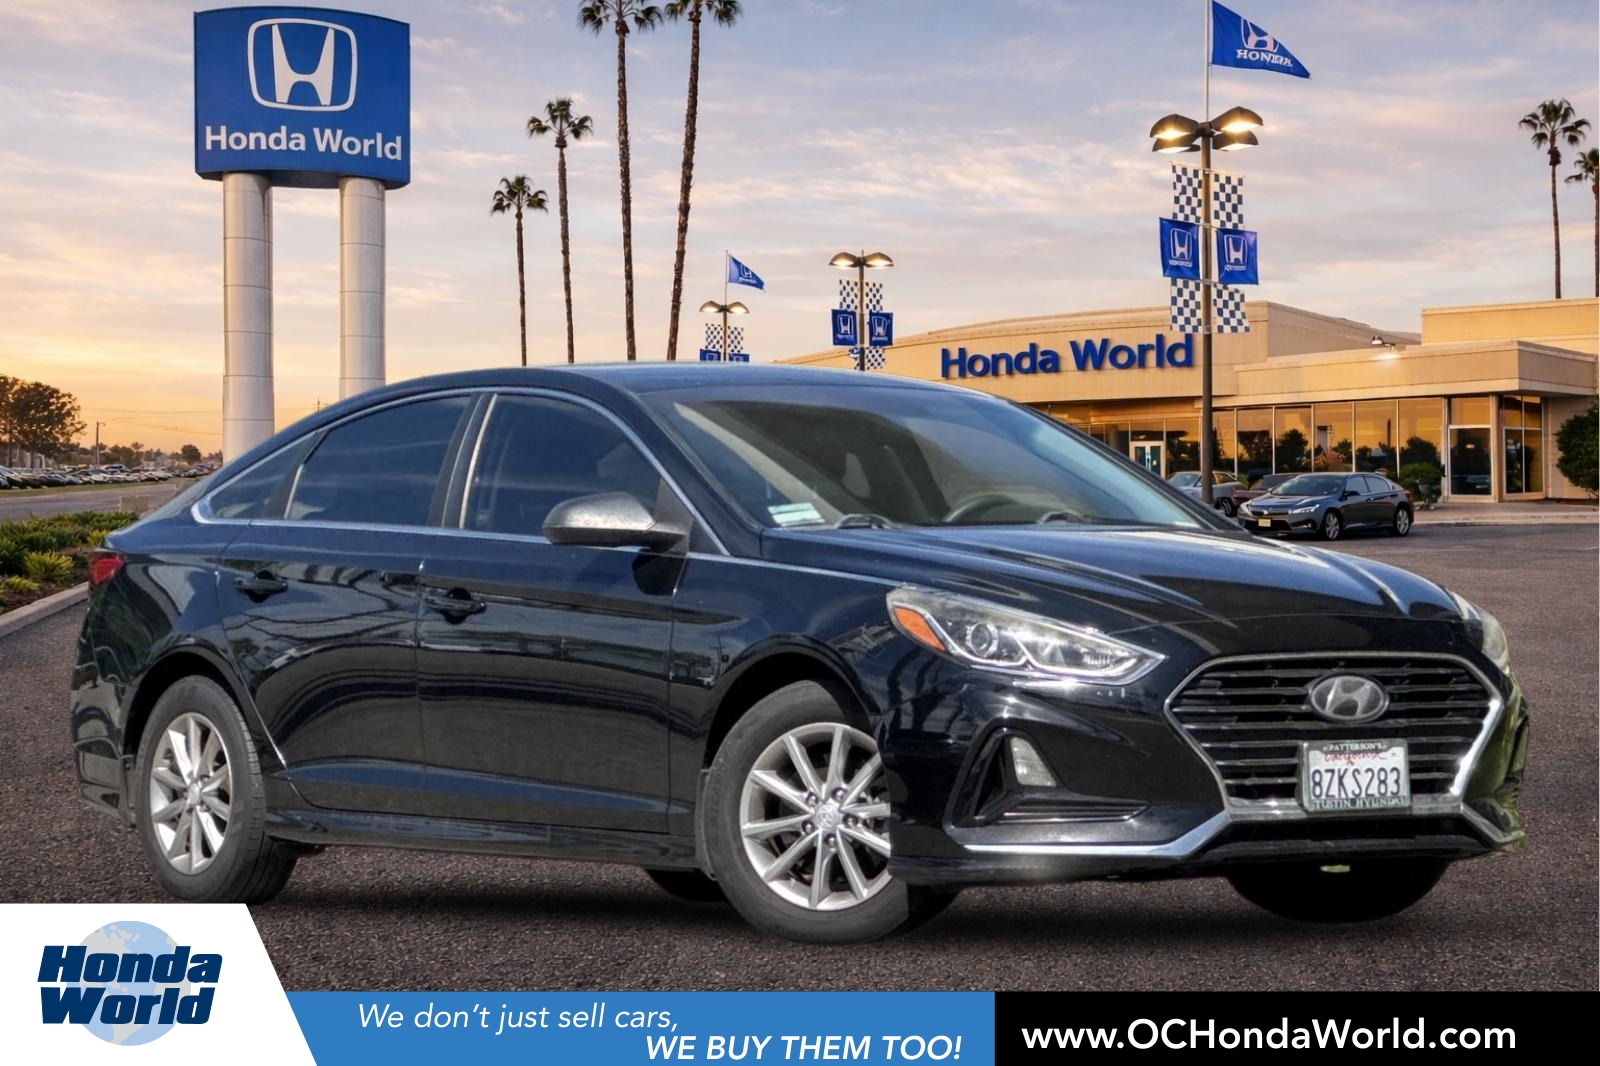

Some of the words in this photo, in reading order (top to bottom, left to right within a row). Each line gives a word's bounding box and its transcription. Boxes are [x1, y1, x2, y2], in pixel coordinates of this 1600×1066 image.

[205, 125, 306, 151] Honda
[312, 127, 402, 161] World
[941, 342, 1061, 378] Honda
[1069, 333, 1194, 371] World
[1312, 766, 1401, 799] 8ZKS283
[1314, 798, 1352, 809] TUSTIN
[1356, 796, 1406, 808] HYUNDAI
